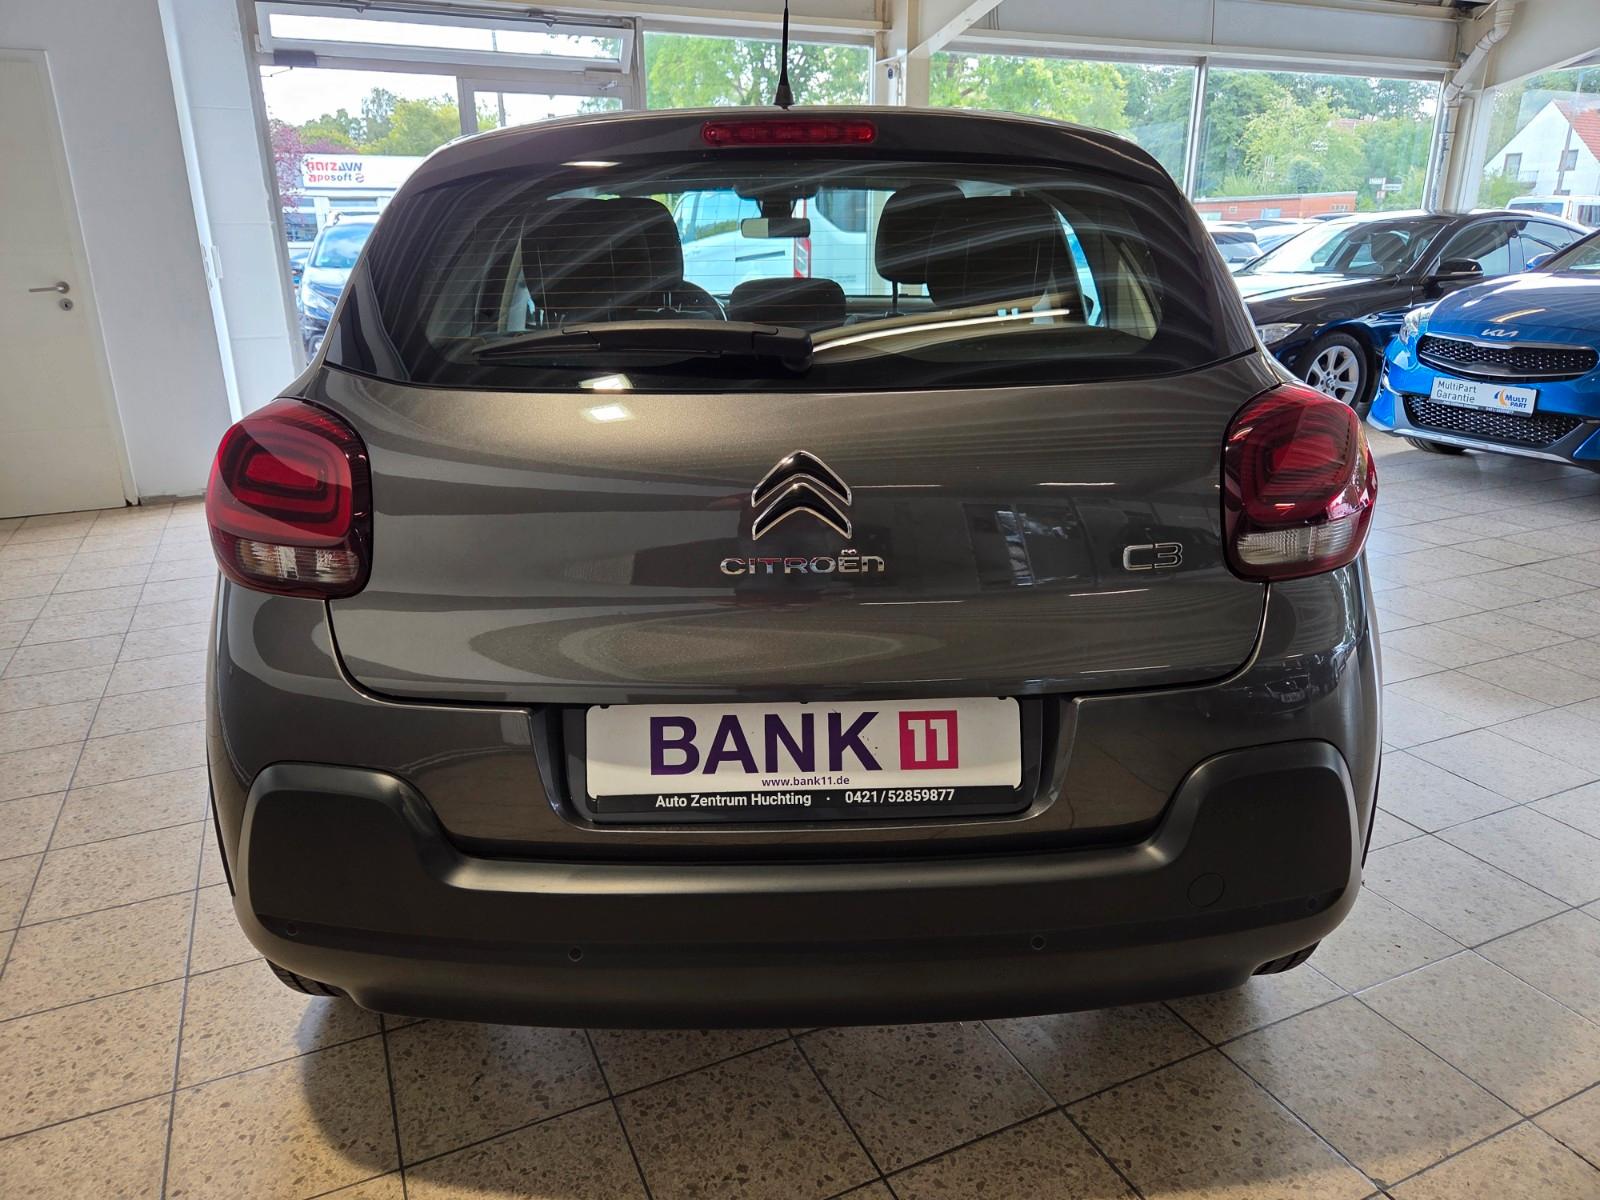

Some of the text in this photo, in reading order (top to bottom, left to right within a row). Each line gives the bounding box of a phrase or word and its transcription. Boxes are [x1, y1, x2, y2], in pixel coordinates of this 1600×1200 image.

[309, 173, 352, 182] aposoft
[1438, 380, 1477, 394] MultiPart
[1436, 389, 1476, 403] Garantie
[1123, 542, 1183, 571] C3
[650, 711, 949, 776] BANK 11
[761, 776, 850, 787] www.bank11.de
[655, 795, 688, 808] Auto
[690, 793, 748, 807] Zentrum
[751, 792, 812, 807] Huchting
